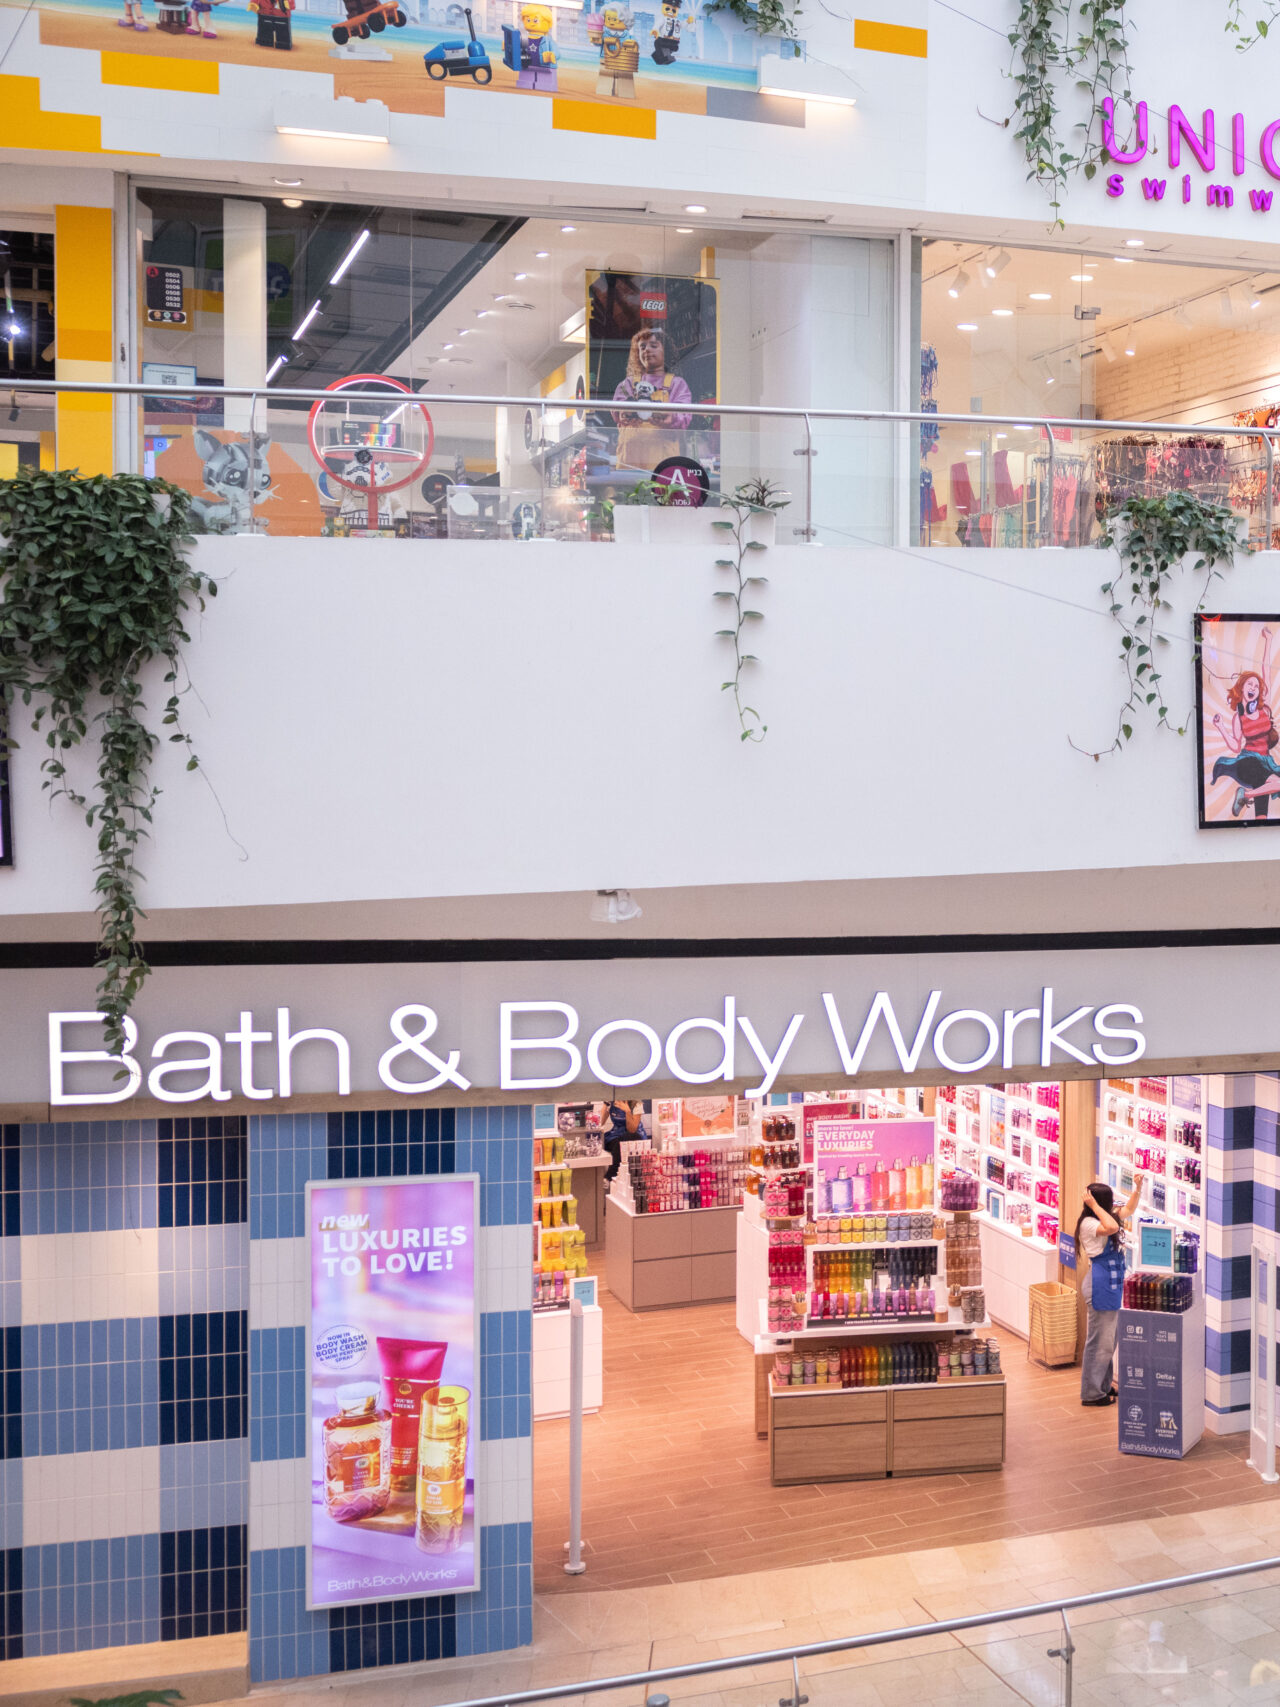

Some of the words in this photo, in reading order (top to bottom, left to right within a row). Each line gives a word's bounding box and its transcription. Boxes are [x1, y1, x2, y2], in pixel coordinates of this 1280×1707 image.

[642, 300, 665, 311] LEGO
[669, 468, 690, 497] A
[48, 1006, 351, 1106] Bath
[378, 1003, 472, 1094] &
[499, 995, 805, 1099] Body
[821, 986, 1146, 1075] Works
[818, 1130, 875, 1141] EVERYDAY
[818, 1140, 874, 1151] LUXURIES
[321, 1213, 369, 1230] new
[323, 1225, 468, 1254] LUXURIES
[322, 1256, 362, 1278] TO
[370, 1249, 454, 1275] LOVE!
[316, 1340, 338, 1351] BODY
[340, 1334, 364, 1345] WASH
[327, 1333, 343, 1341] NOW
[315, 1347, 338, 1358] BODY
[339, 1339, 368, 1352] CREAM
